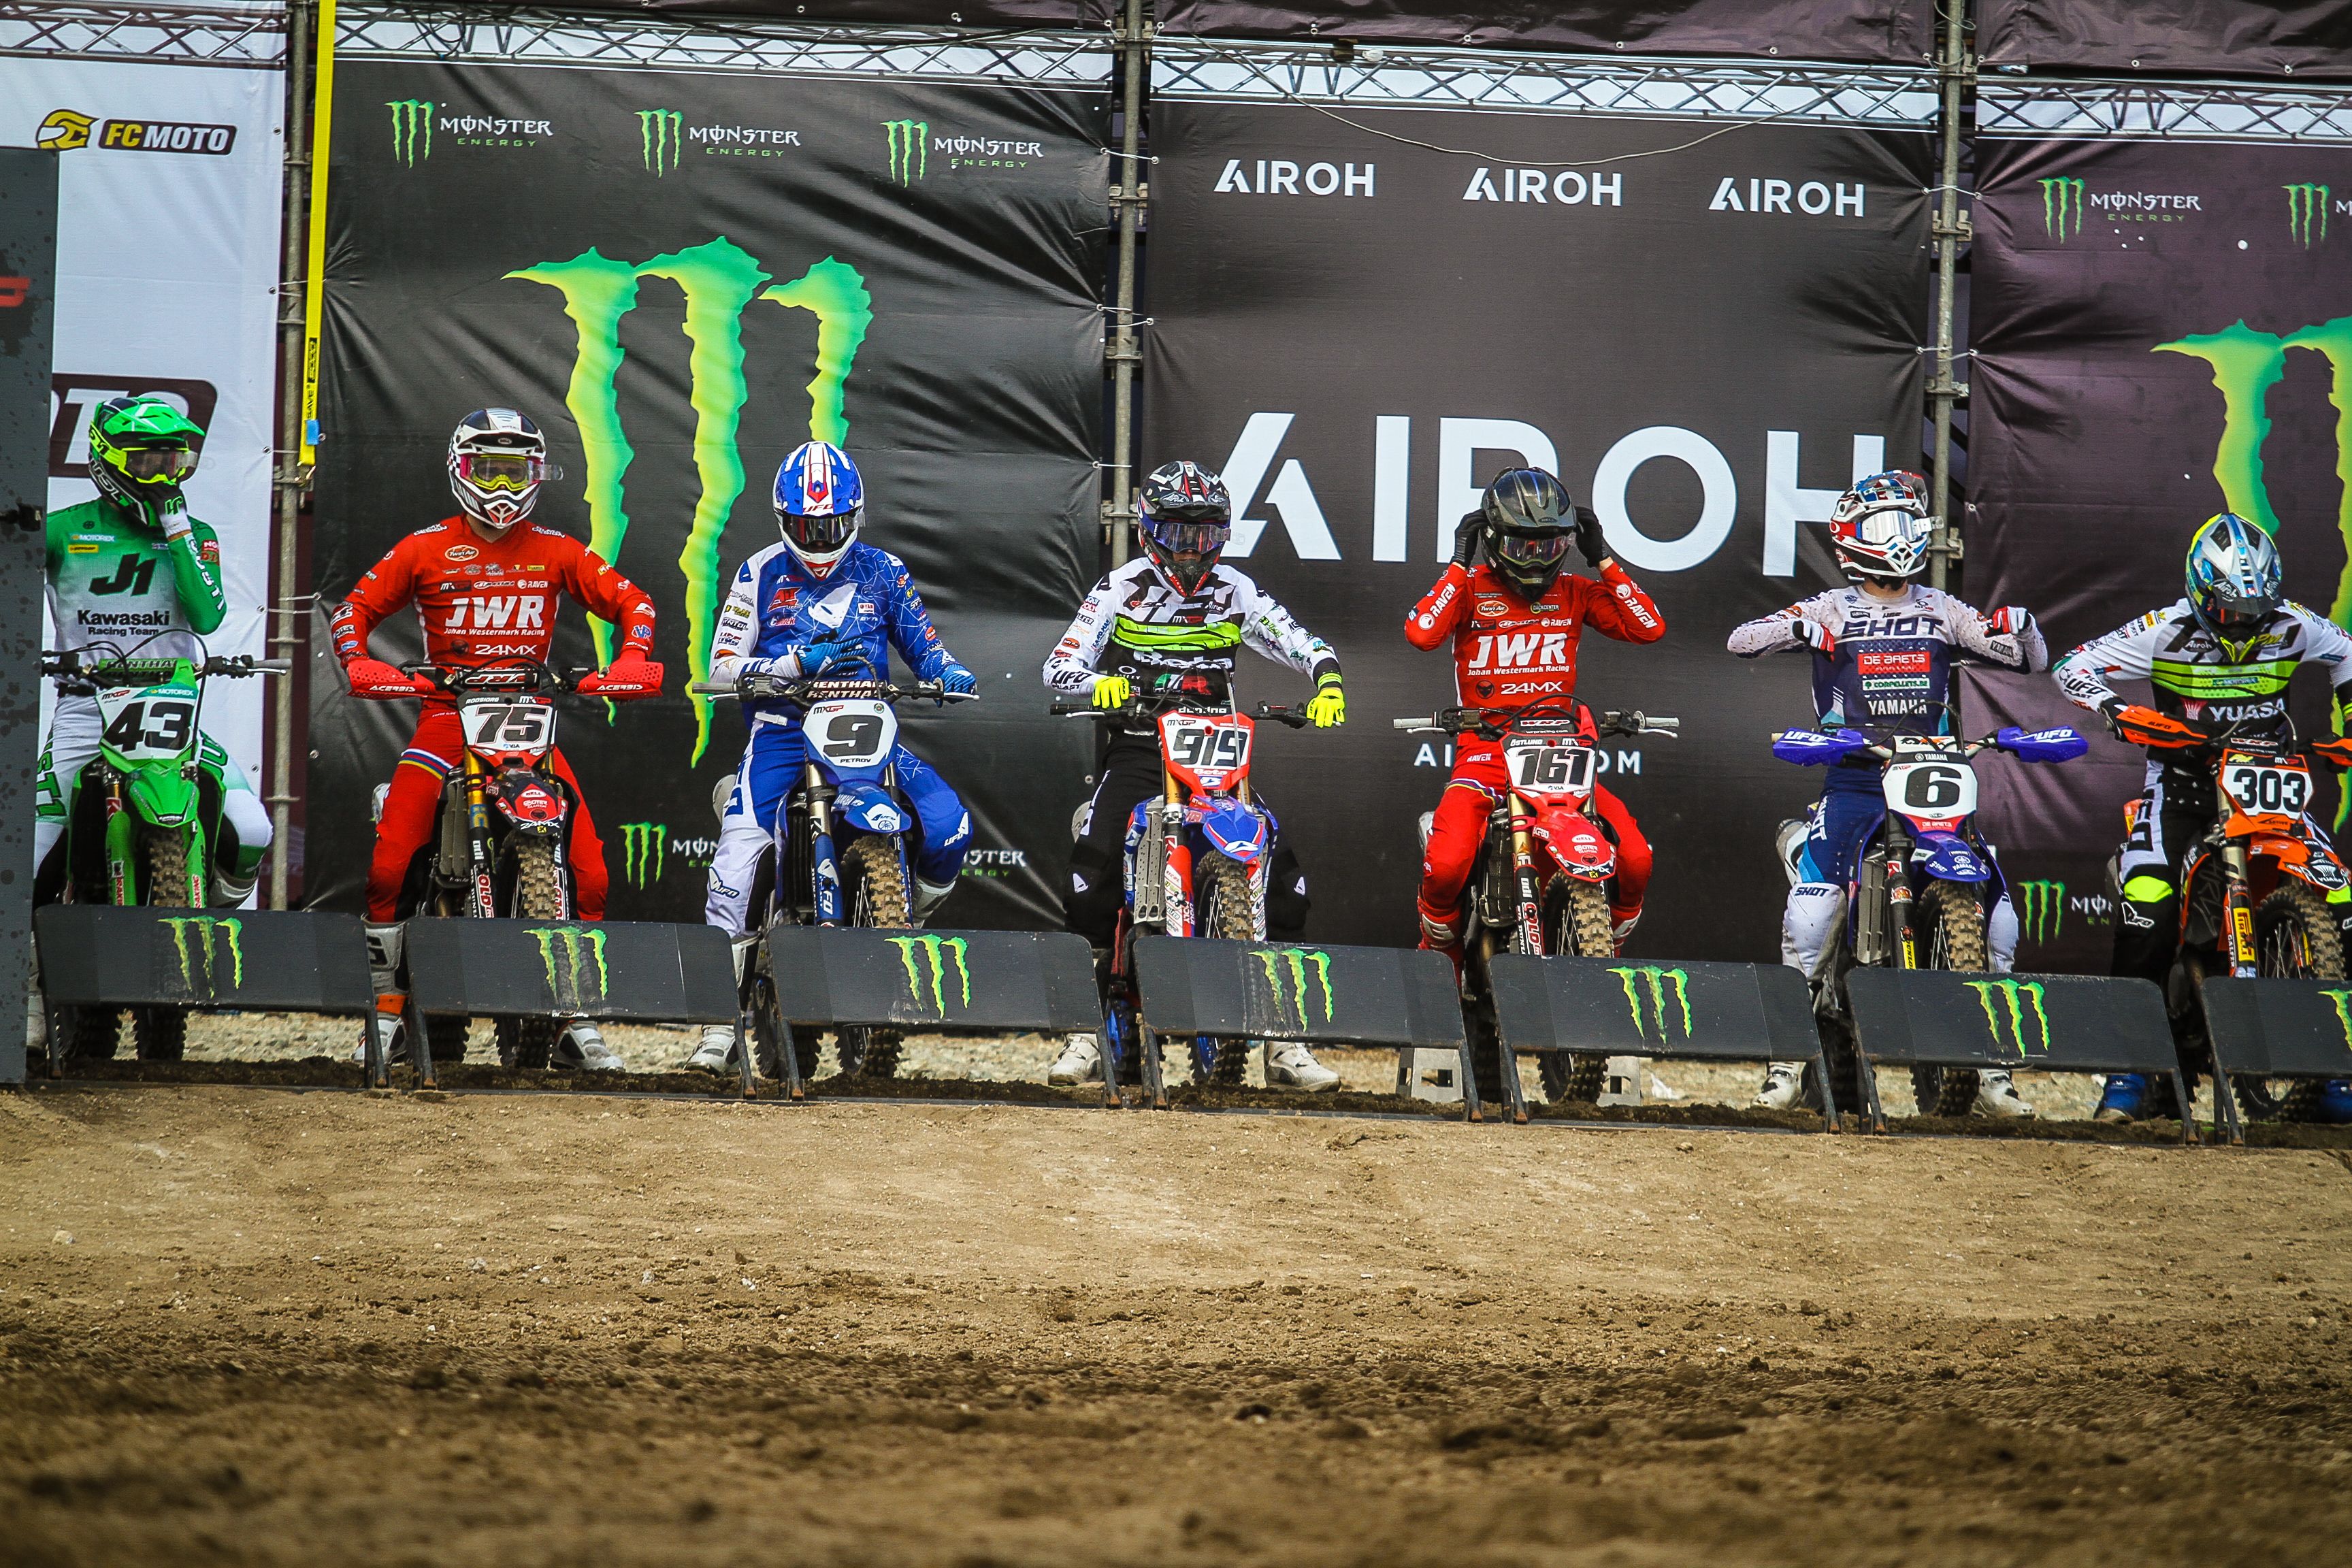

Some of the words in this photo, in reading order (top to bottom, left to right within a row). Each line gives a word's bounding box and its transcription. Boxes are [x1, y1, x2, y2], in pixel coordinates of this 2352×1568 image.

[440, 116, 553, 136] MONSTER
[144, 125, 229, 151] MOTO
[457, 138, 537, 146] ENERGY
[689, 125, 801, 147] MONSTER
[706, 148, 785, 157] ENERGY
[934, 136, 1044, 158] MONSTER
[951, 158, 1028, 168] ENERGY
[1213, 159, 1375, 197] AIROH
[1462, 167, 1622, 206] AIROH
[1708, 177, 1865, 218] AIROH
[2090, 191, 2203, 212] MONSTER
[2108, 213, 2185, 223] ENERGY
[527, 581, 549, 589] RAVEN
[1429, 583, 1456, 617] RAVEN
[77, 610, 170, 626] Kawasaki
[444, 595, 545, 628] JWR
[1624, 597, 1658, 629] RAVEN
[1550, 618, 1572, 627] RAVEN
[1841, 617, 1944, 639] SHOT
[88, 627, 129, 637] Racing
[130, 627, 159, 636] Team
[468, 627, 520, 636] Westermark
[521, 628, 545, 636] Racing
[474, 644, 538, 655] 24MX
[1467, 632, 1568, 668] JWR
[2184, 640, 2212, 649] Airoh
[1863, 655, 1881, 666] DE
[1052, 669, 1094, 685] UFO
[1493, 666, 1544, 675] Westermark
[1545, 664, 1570, 672] Racing
[596, 683, 644, 691] ACERBIS
[1500, 681, 1563, 695] 24MX
[2065, 678, 2108, 696] UFO
[813, 704, 845, 715] MXGP
[1867, 698, 1927, 716] YAMAHA
[2208, 698, 2285, 722] YUASA
[103, 700, 195, 753] 43
[474, 704, 549, 747] 75
[823, 715, 884, 757] 9
[1509, 738, 1544, 747] ÖSTLUND
[1784, 730, 1825, 743] UFO
[2036, 729, 2073, 740] UFO
[1173, 728, 1248, 768] 919
[1466, 753, 1492, 763] RAVEN
[1924, 753, 1948, 762] YAMAHA
[1516, 748, 1591, 787] 161
[1904, 766, 1963, 808] 6
[2233, 768, 2306, 813] 303
[1795, 886, 1830, 898] SHOT
